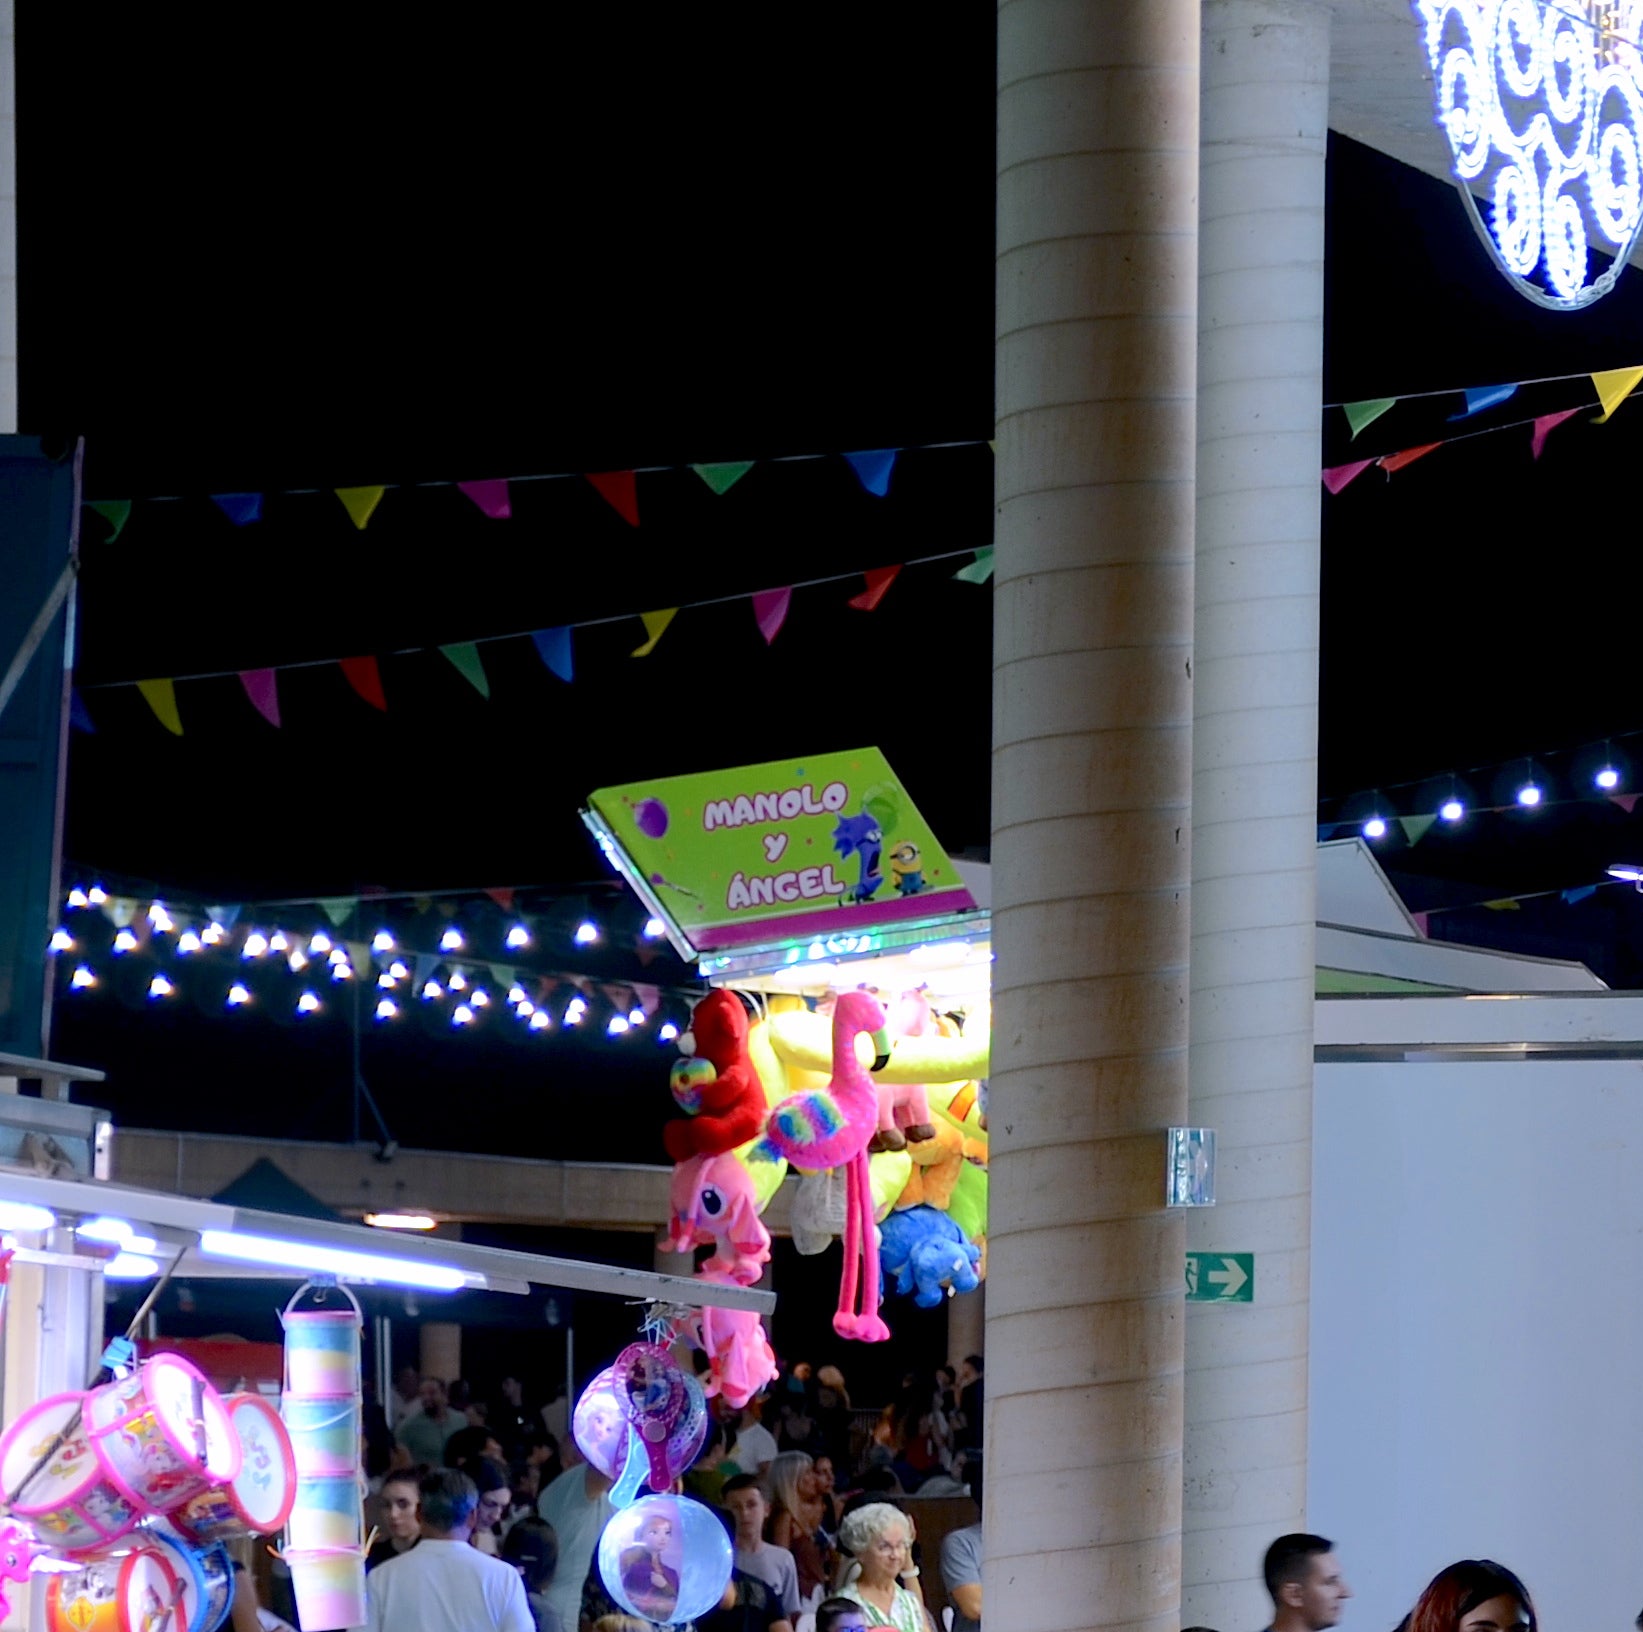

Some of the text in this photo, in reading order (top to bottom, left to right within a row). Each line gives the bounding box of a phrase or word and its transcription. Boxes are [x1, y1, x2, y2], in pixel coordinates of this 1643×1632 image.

[703, 781, 849, 832] MANOLO
[763, 832, 788, 863] Y
[726, 863, 846, 911] ÁNGEL
